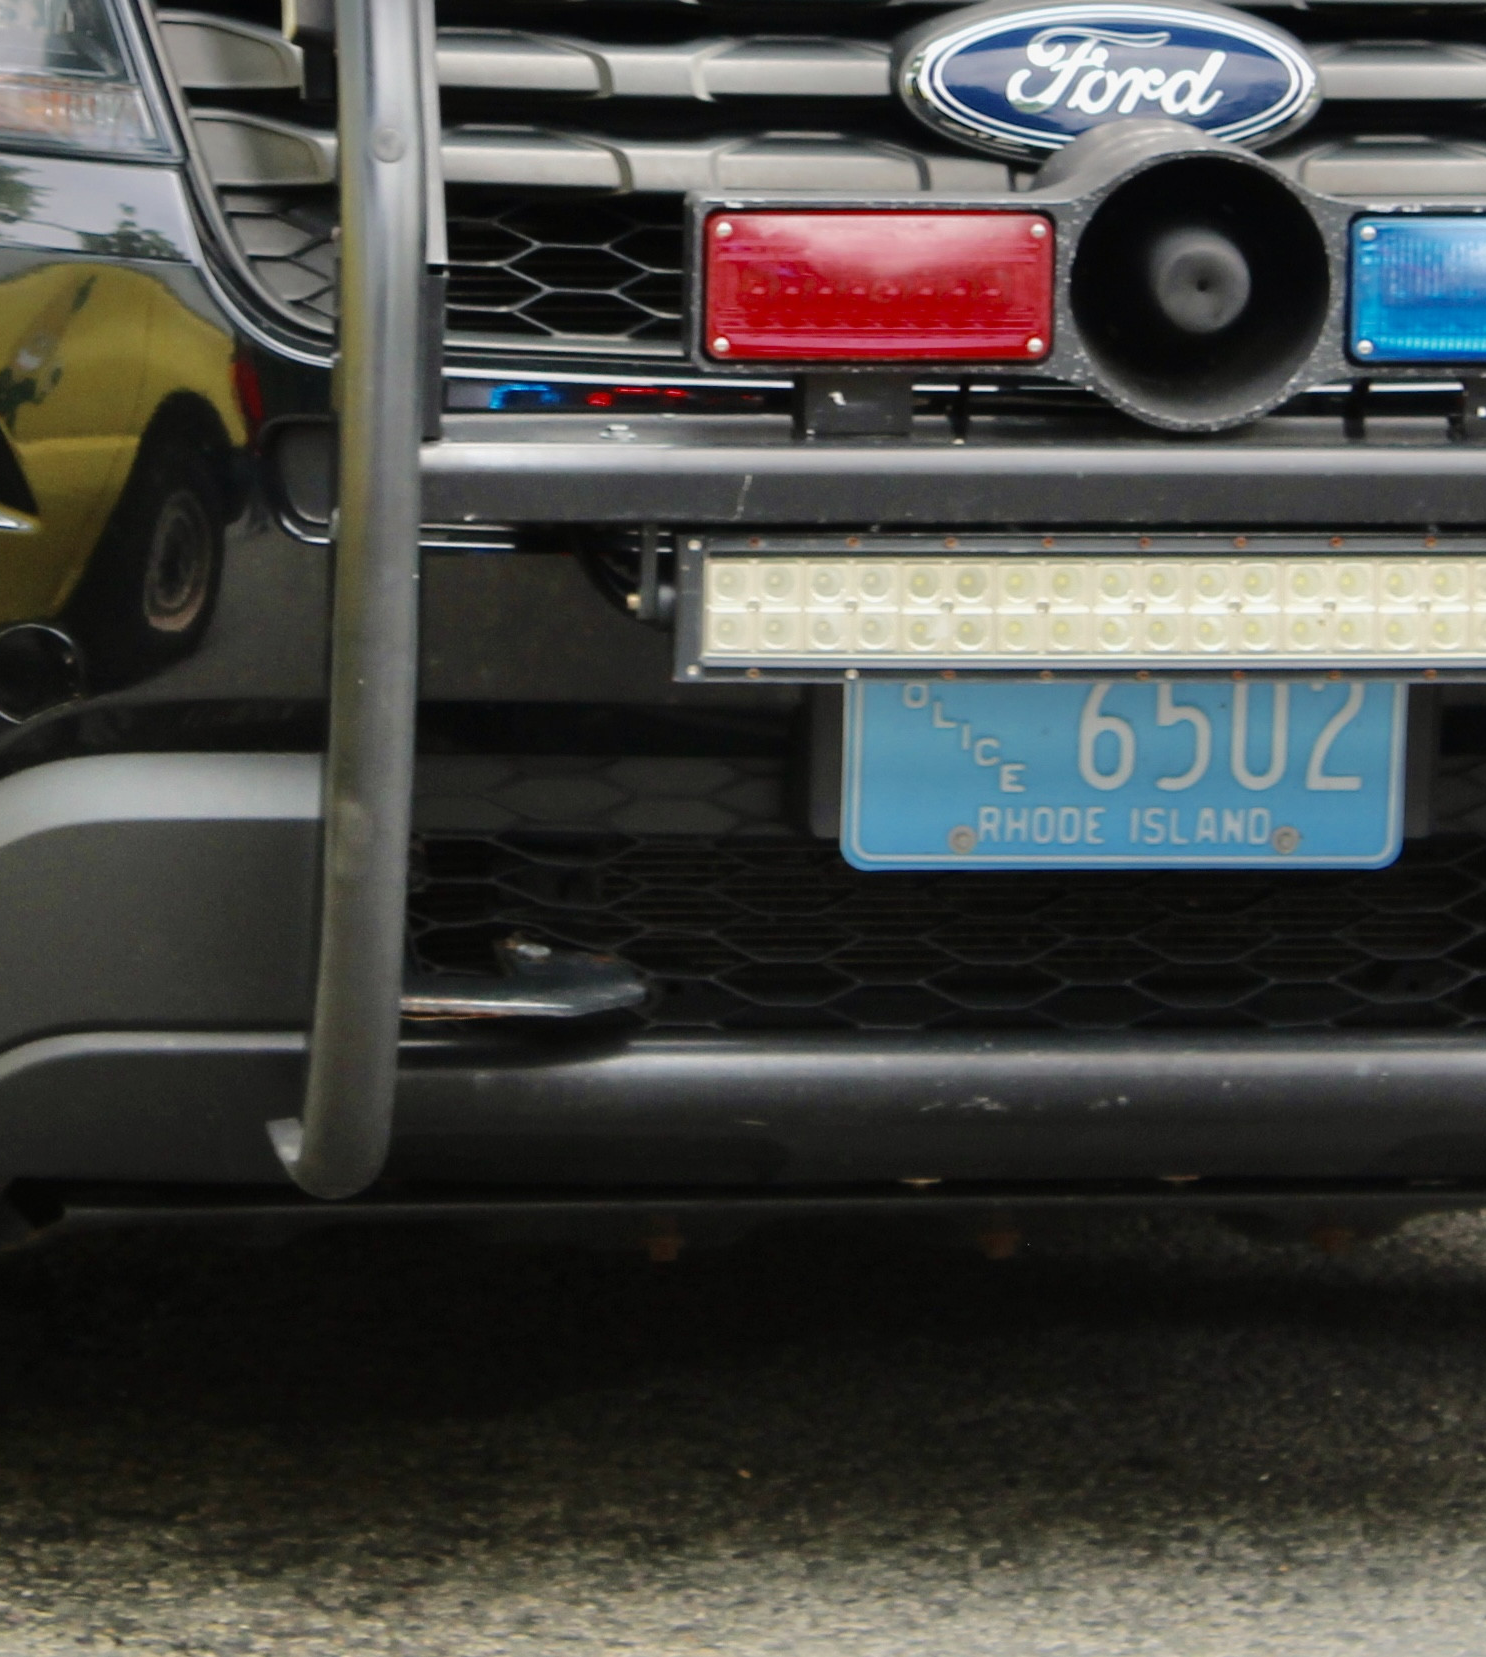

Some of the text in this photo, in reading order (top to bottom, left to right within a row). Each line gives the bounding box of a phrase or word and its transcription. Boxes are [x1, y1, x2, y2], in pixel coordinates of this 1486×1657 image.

[1004, 25, 1227, 117] Ford
[903, 684, 1026, 793] OLICE
[1078, 683, 1363, 791] 6502
[977, 806, 1271, 845] RHODE ISLAND
